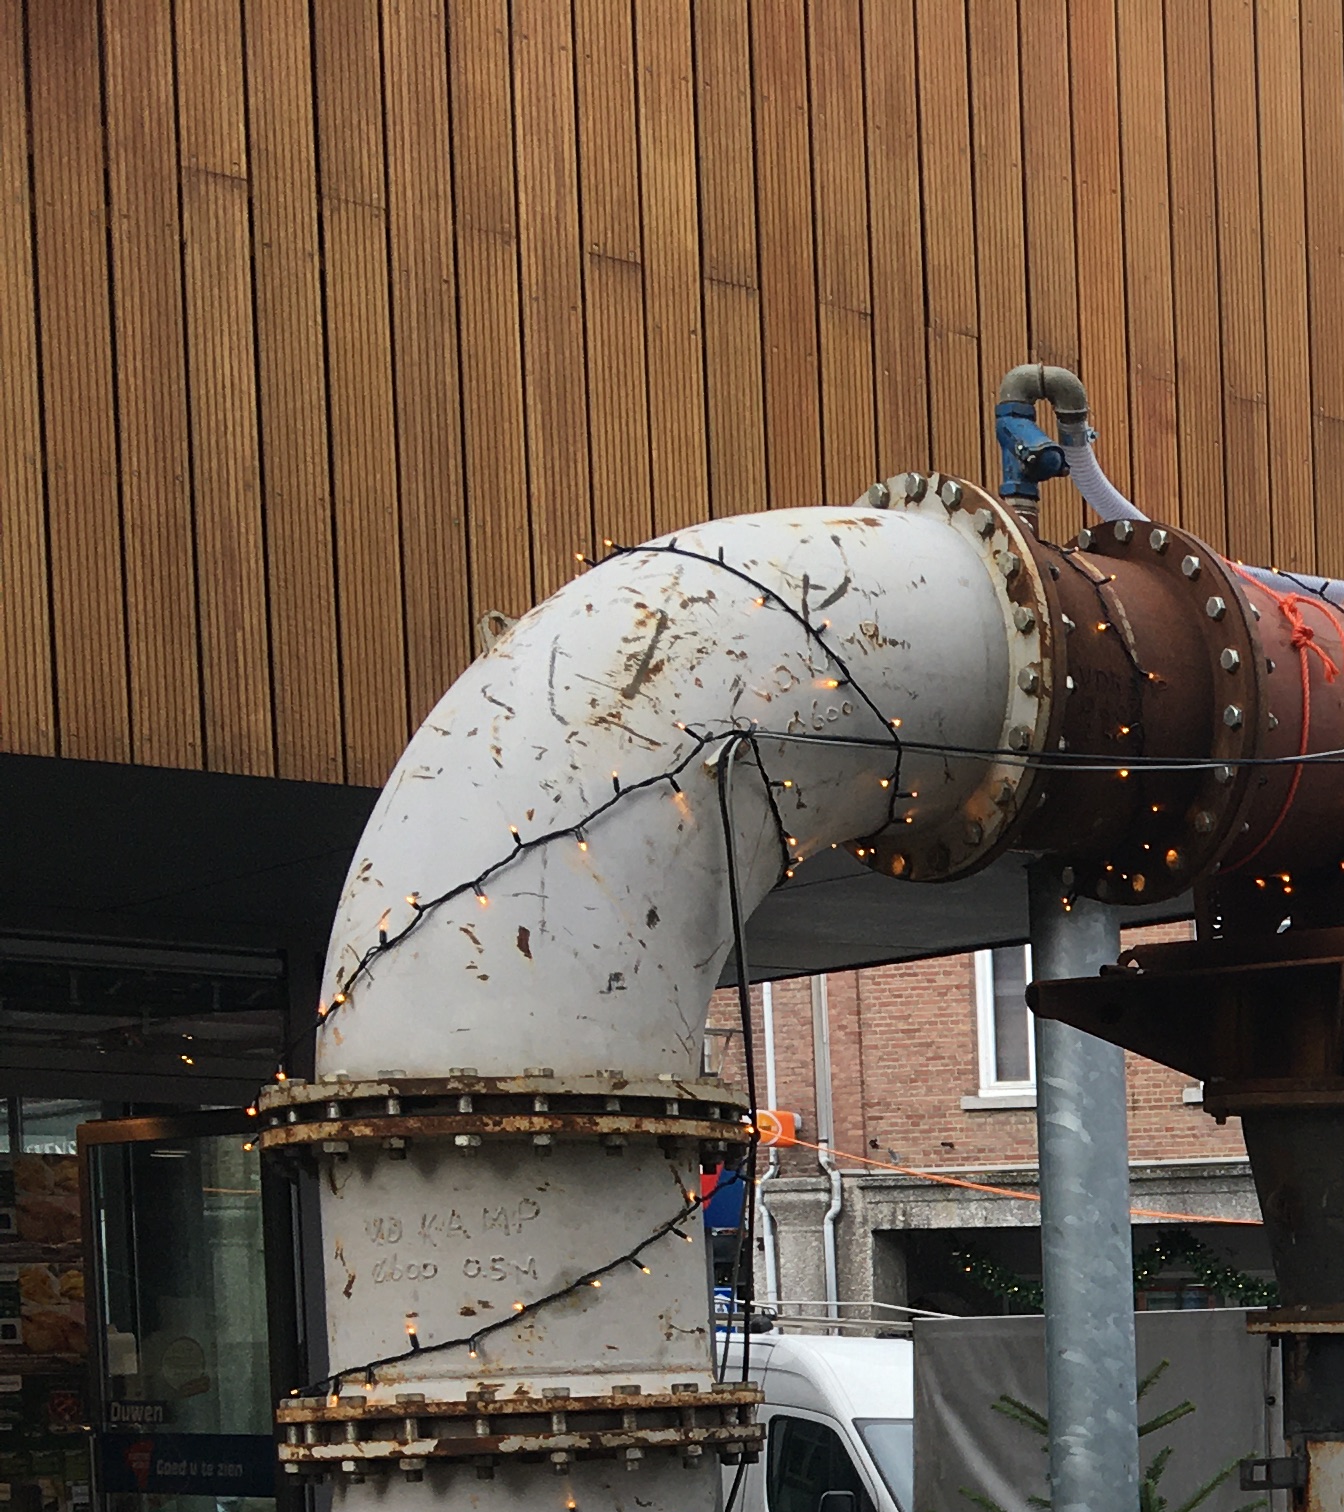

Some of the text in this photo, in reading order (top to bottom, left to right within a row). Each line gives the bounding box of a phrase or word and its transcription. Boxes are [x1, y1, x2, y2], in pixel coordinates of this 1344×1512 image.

[110, 1401, 163, 1422] Duwen
[156, 1459, 186, 1476] Goed
[217, 1463, 243, 1477] zien
